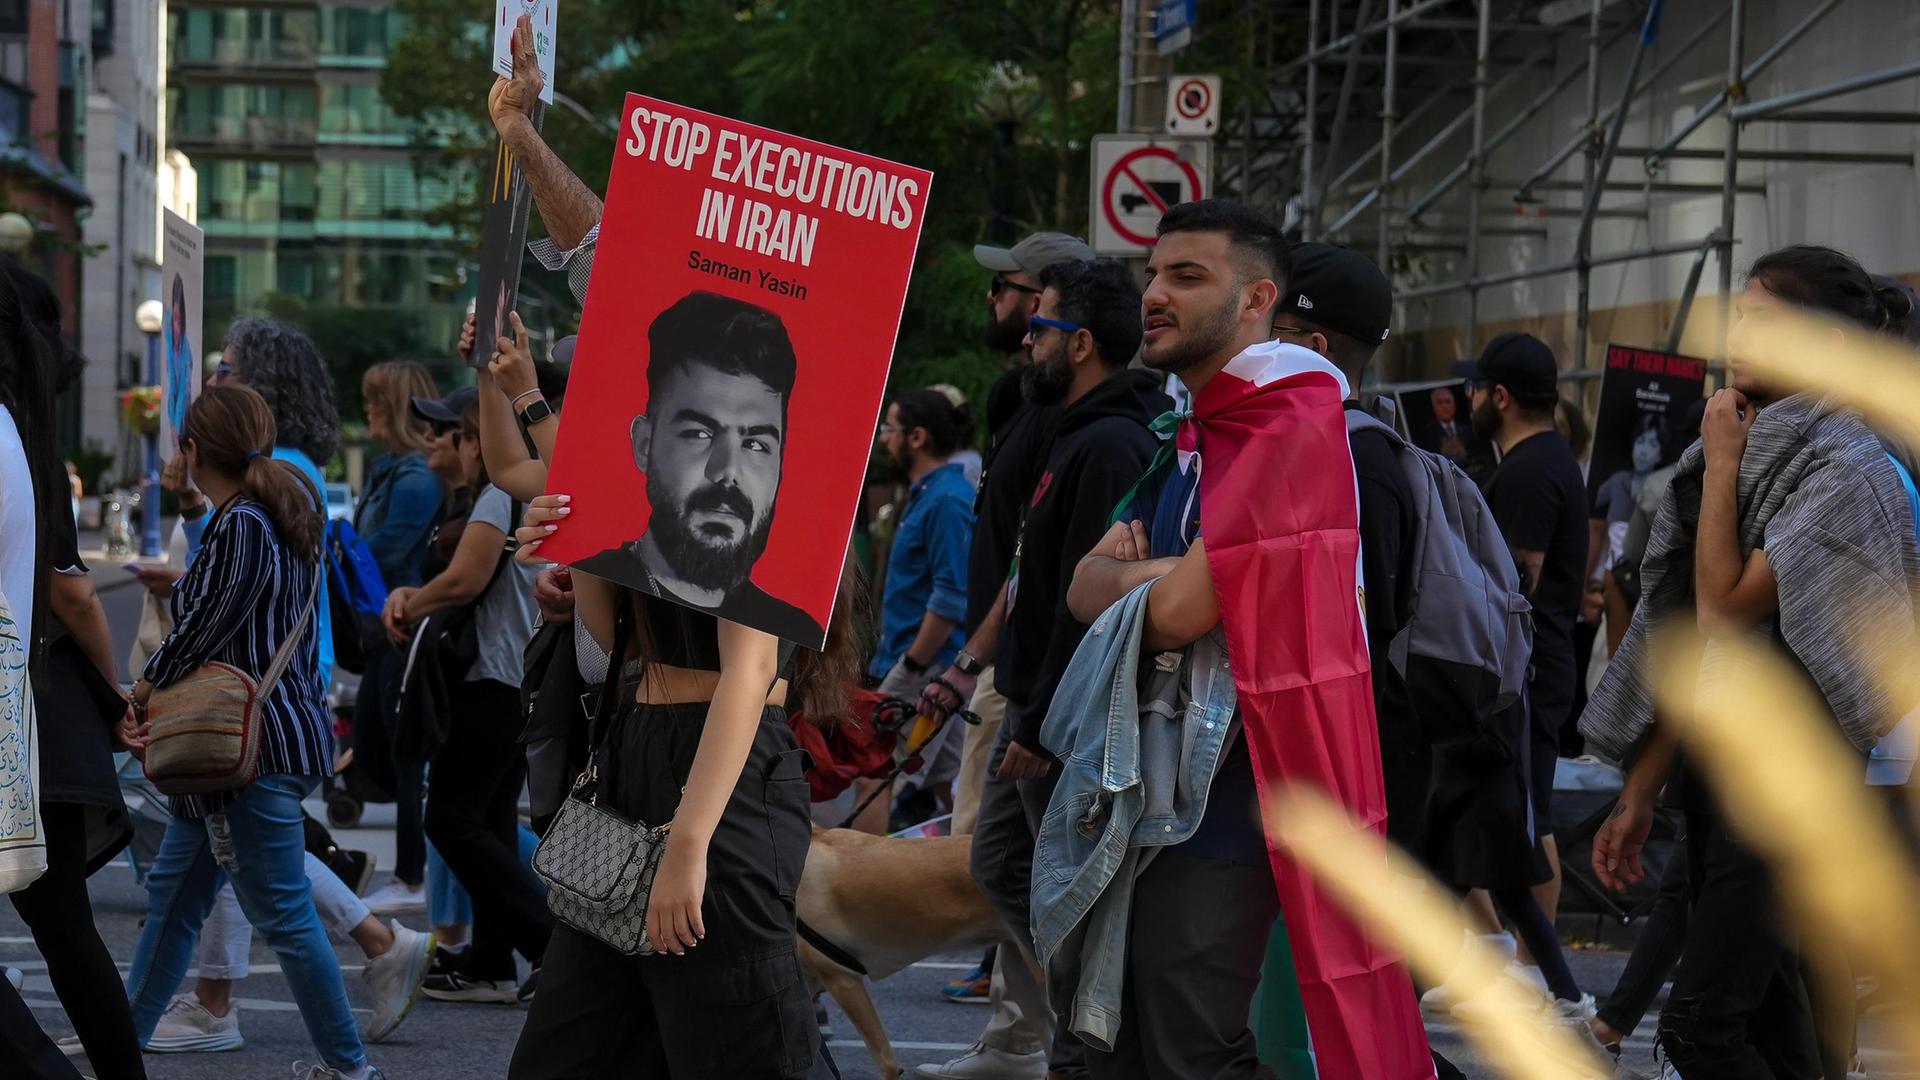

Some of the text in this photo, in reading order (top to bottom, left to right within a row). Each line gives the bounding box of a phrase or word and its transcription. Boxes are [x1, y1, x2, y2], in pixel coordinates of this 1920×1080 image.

[625, 106, 918, 230] STOP EXECUTIONS
[695, 188, 820, 267] IN IRAN
[687, 250, 808, 301] Saman Yasin
[1608, 347, 1706, 381] SAY THEIR NAMES
